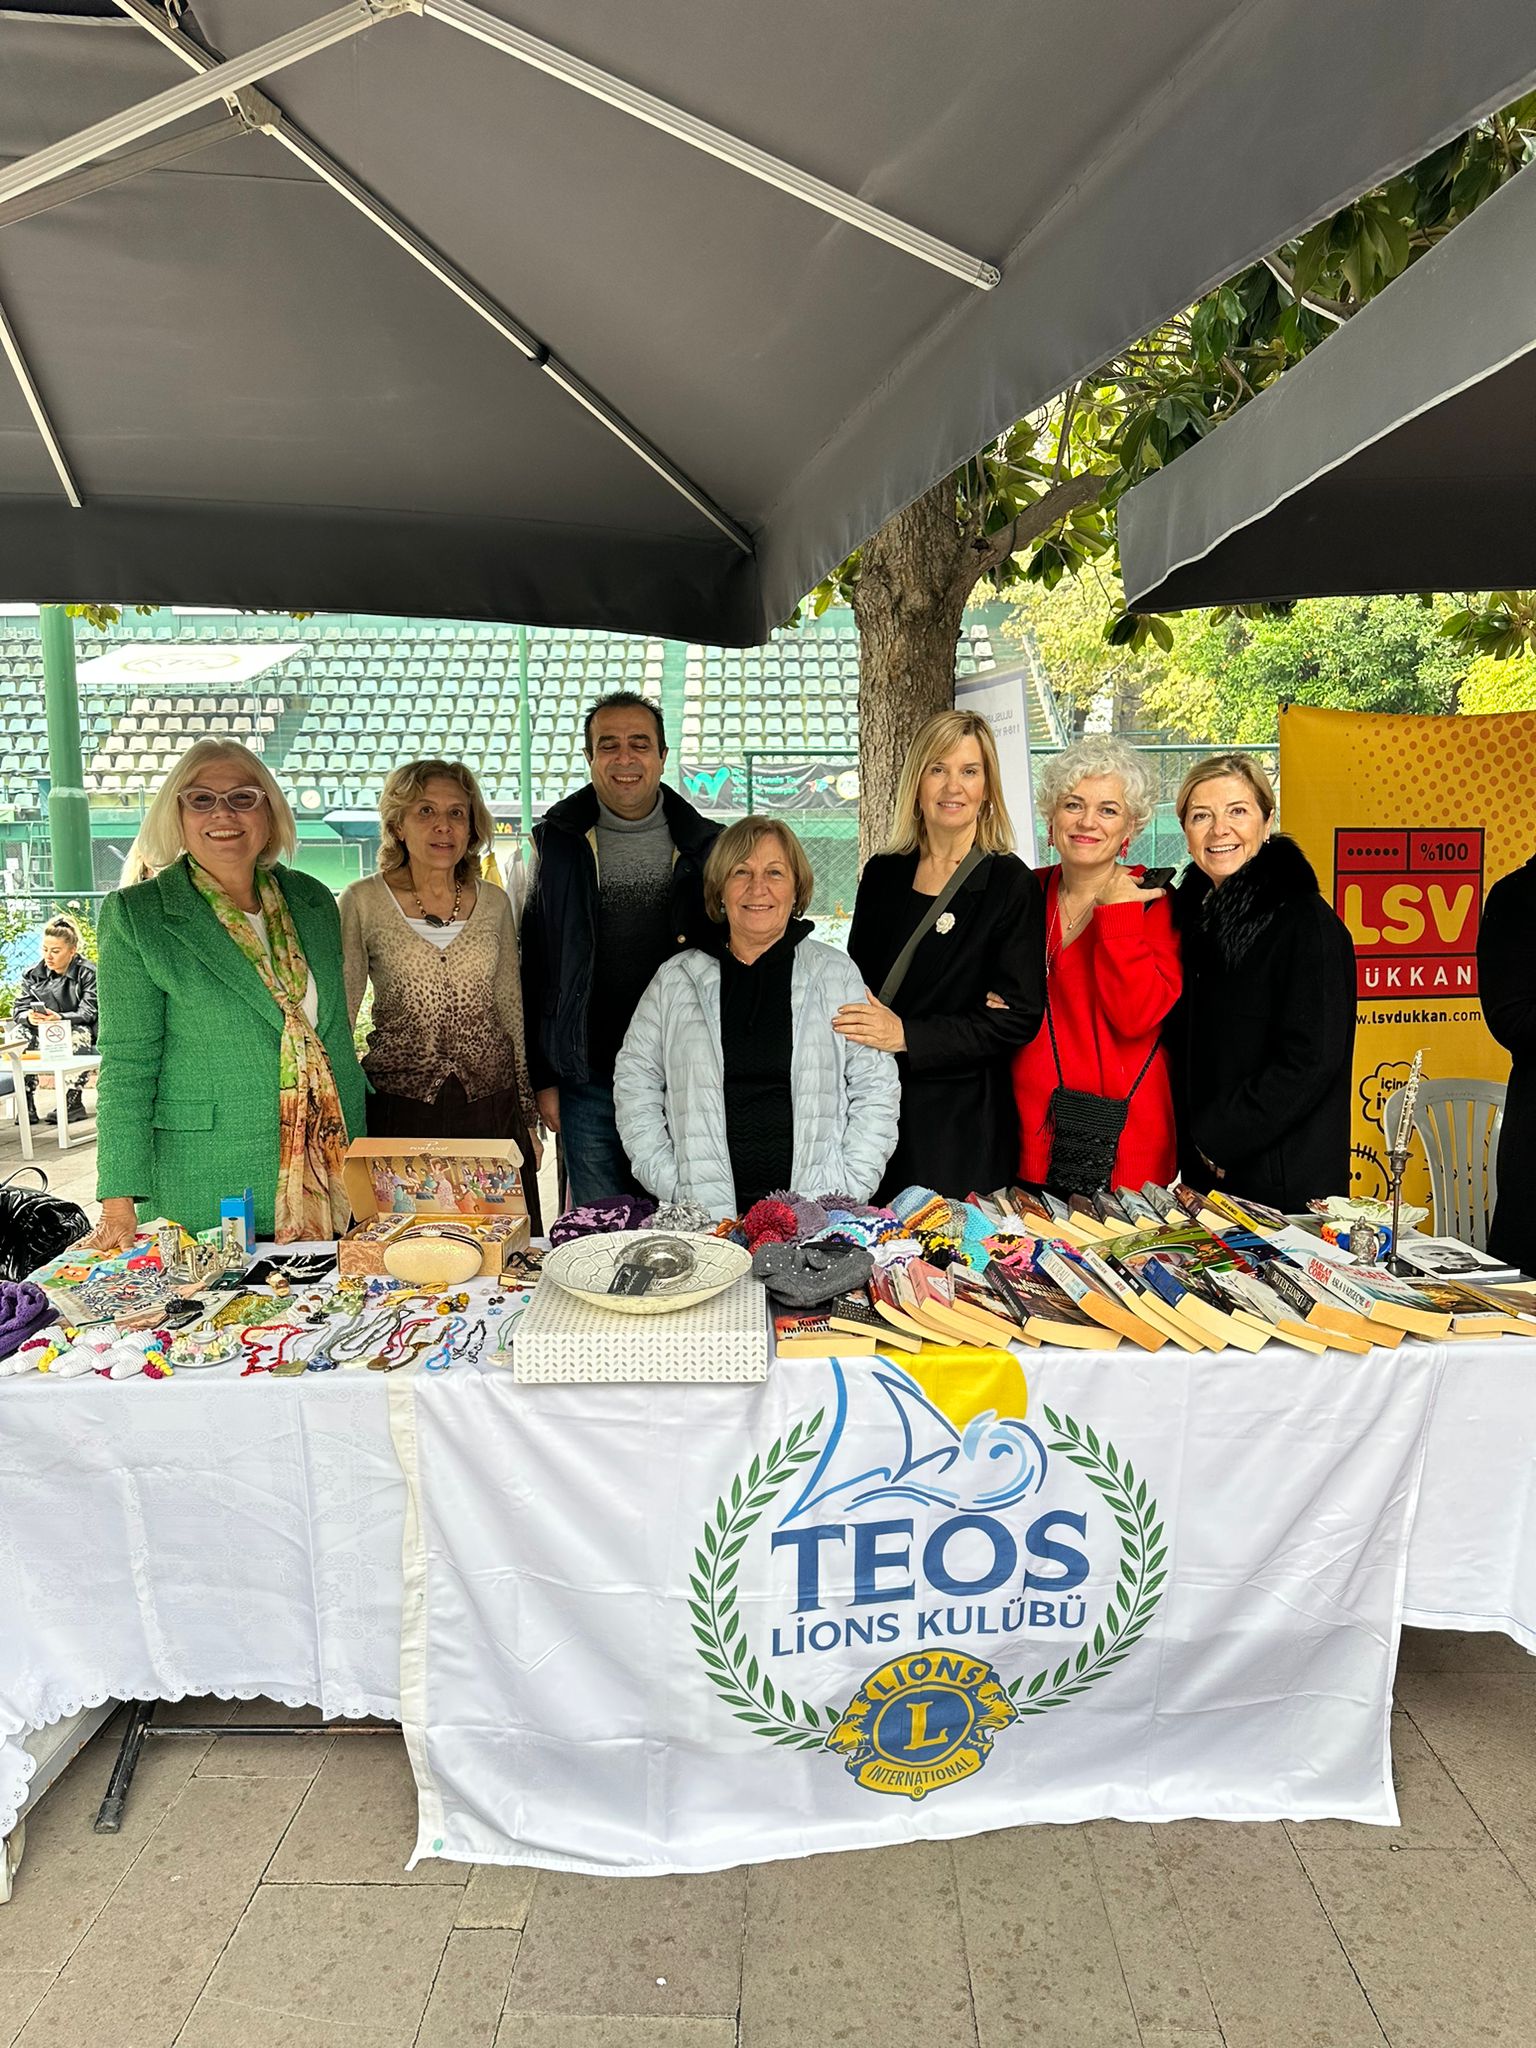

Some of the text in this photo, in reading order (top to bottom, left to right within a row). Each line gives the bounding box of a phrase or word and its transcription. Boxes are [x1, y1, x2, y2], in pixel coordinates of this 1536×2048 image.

[1421, 843, 1468, 861] %100
[1344, 883, 1474, 945] LSV
[1365, 965, 1471, 988] ÜKKAN
[1356, 1009, 1481, 1025] w.lsvdukkan.com
[1308, 1267, 1331, 1285] COBEN
[798, 1319, 829, 1327] KURTL
[771, 1509, 1090, 1614] TEOS
[772, 1594, 1086, 1657] LİONS KULÜBÜ
[873, 1656, 983, 1696] LIONS
[904, 1701, 948, 1750] L
[867, 1757, 974, 1787] INTERNATIONAL
